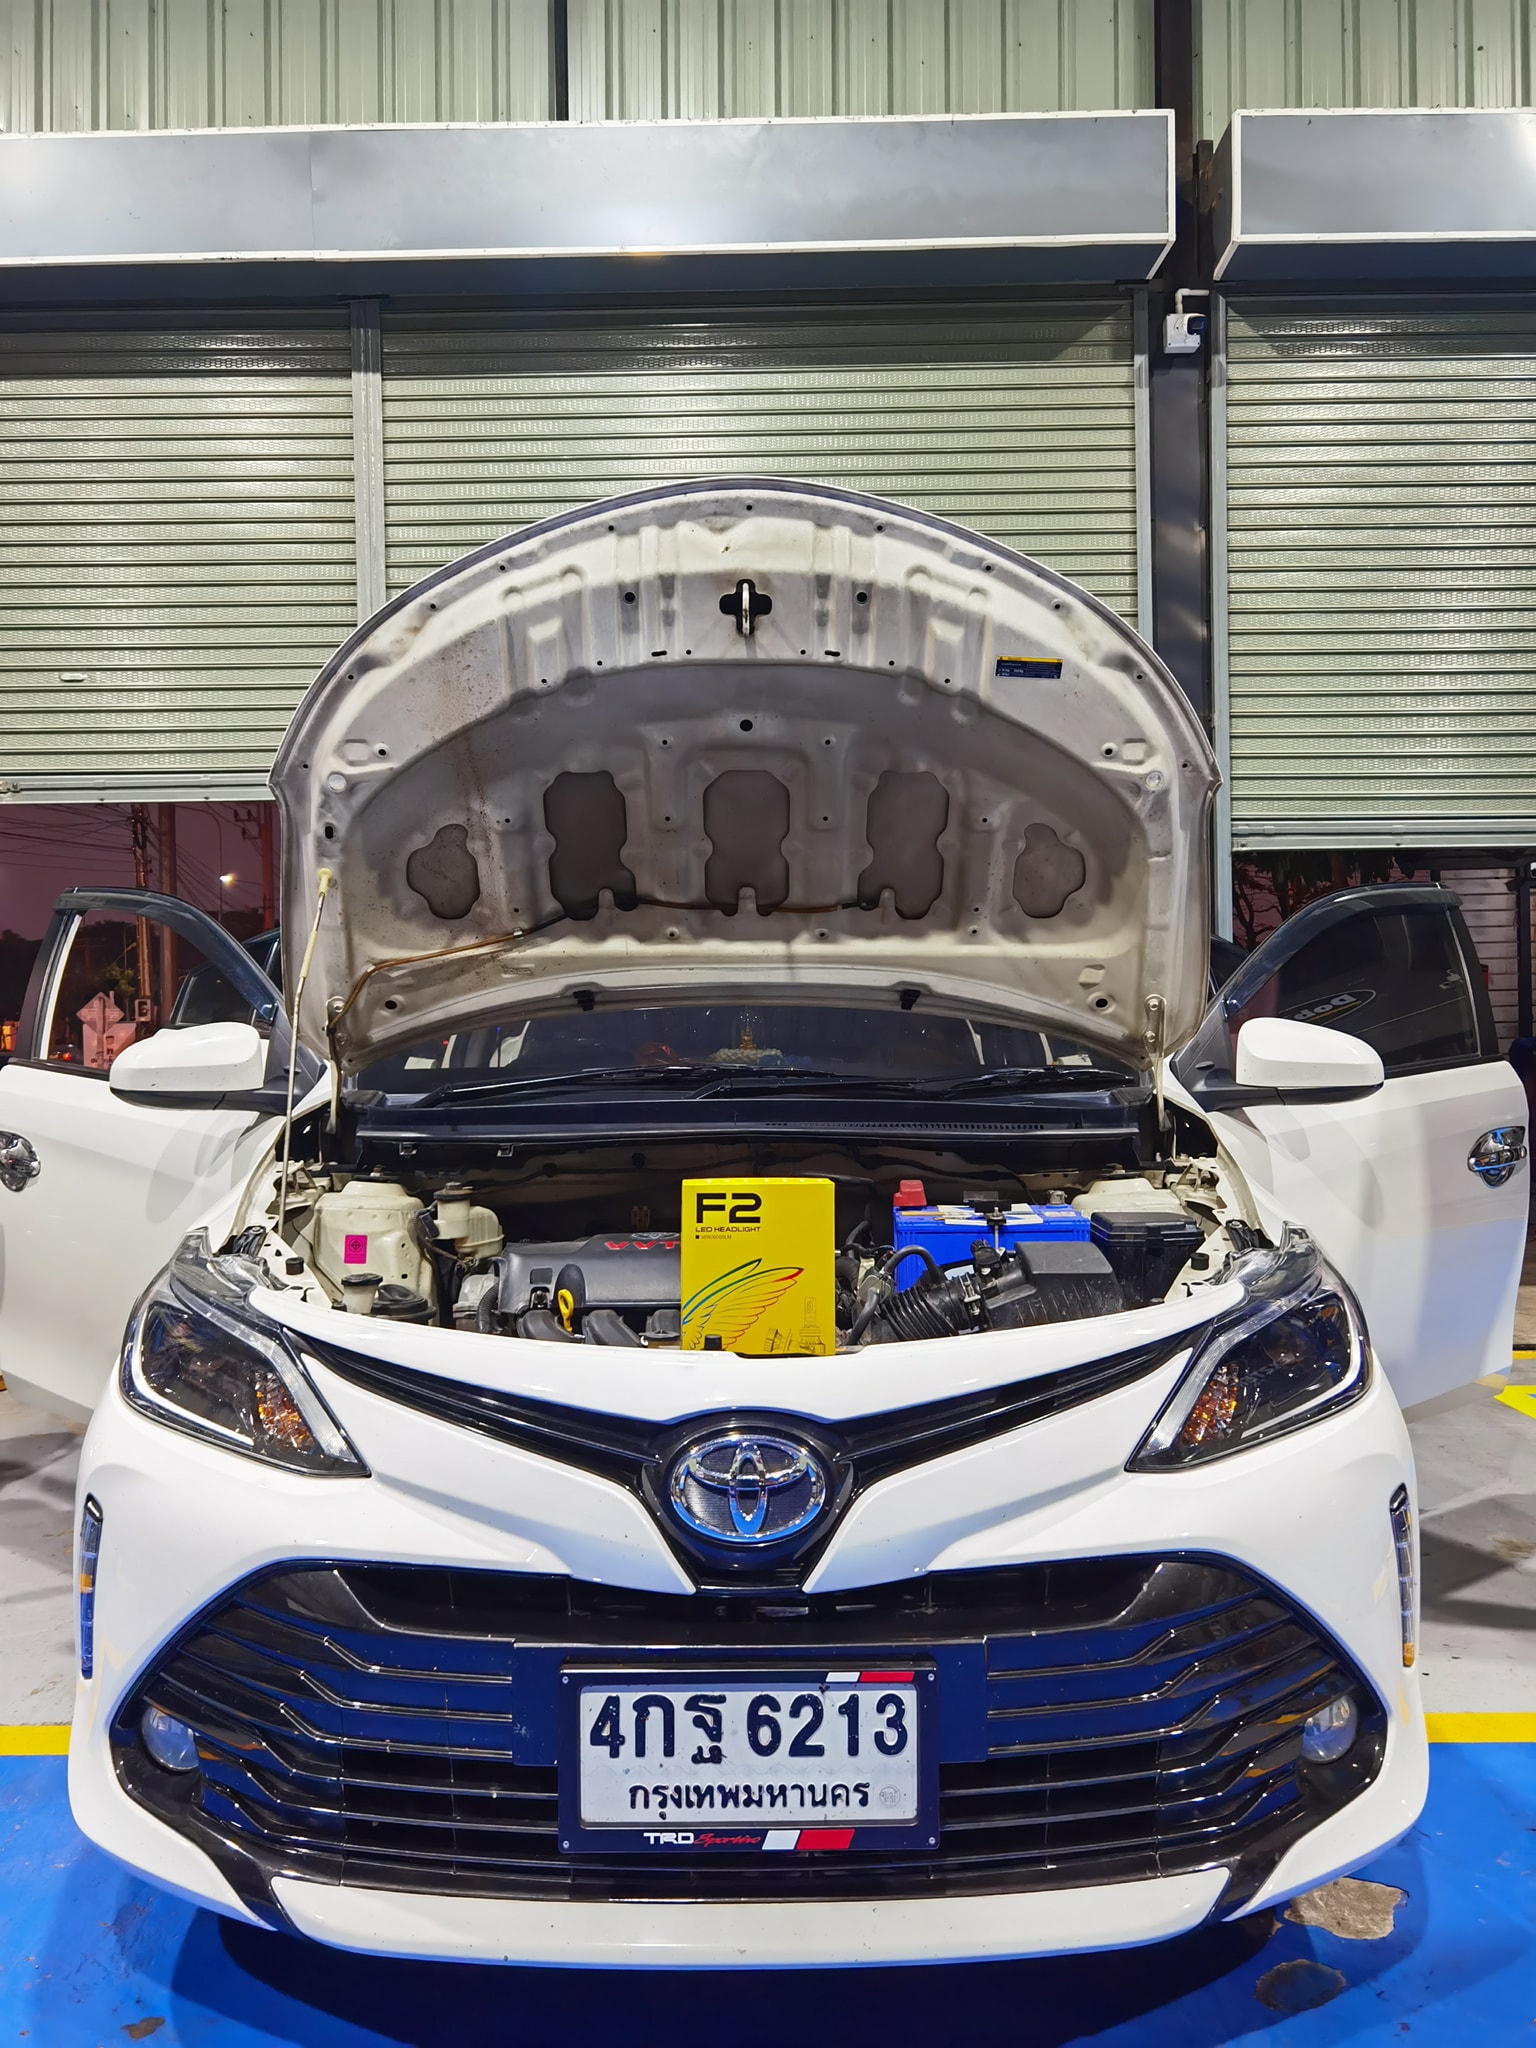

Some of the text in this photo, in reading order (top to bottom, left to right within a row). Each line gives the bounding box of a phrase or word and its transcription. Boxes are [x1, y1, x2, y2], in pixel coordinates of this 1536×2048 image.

[696, 1193, 762, 1223] F2
[590, 1693, 908, 1764] 4กฐ 6213
[629, 1782, 870, 1820] กรุงเทพมหานคร
[643, 1832, 694, 1845] TRD
